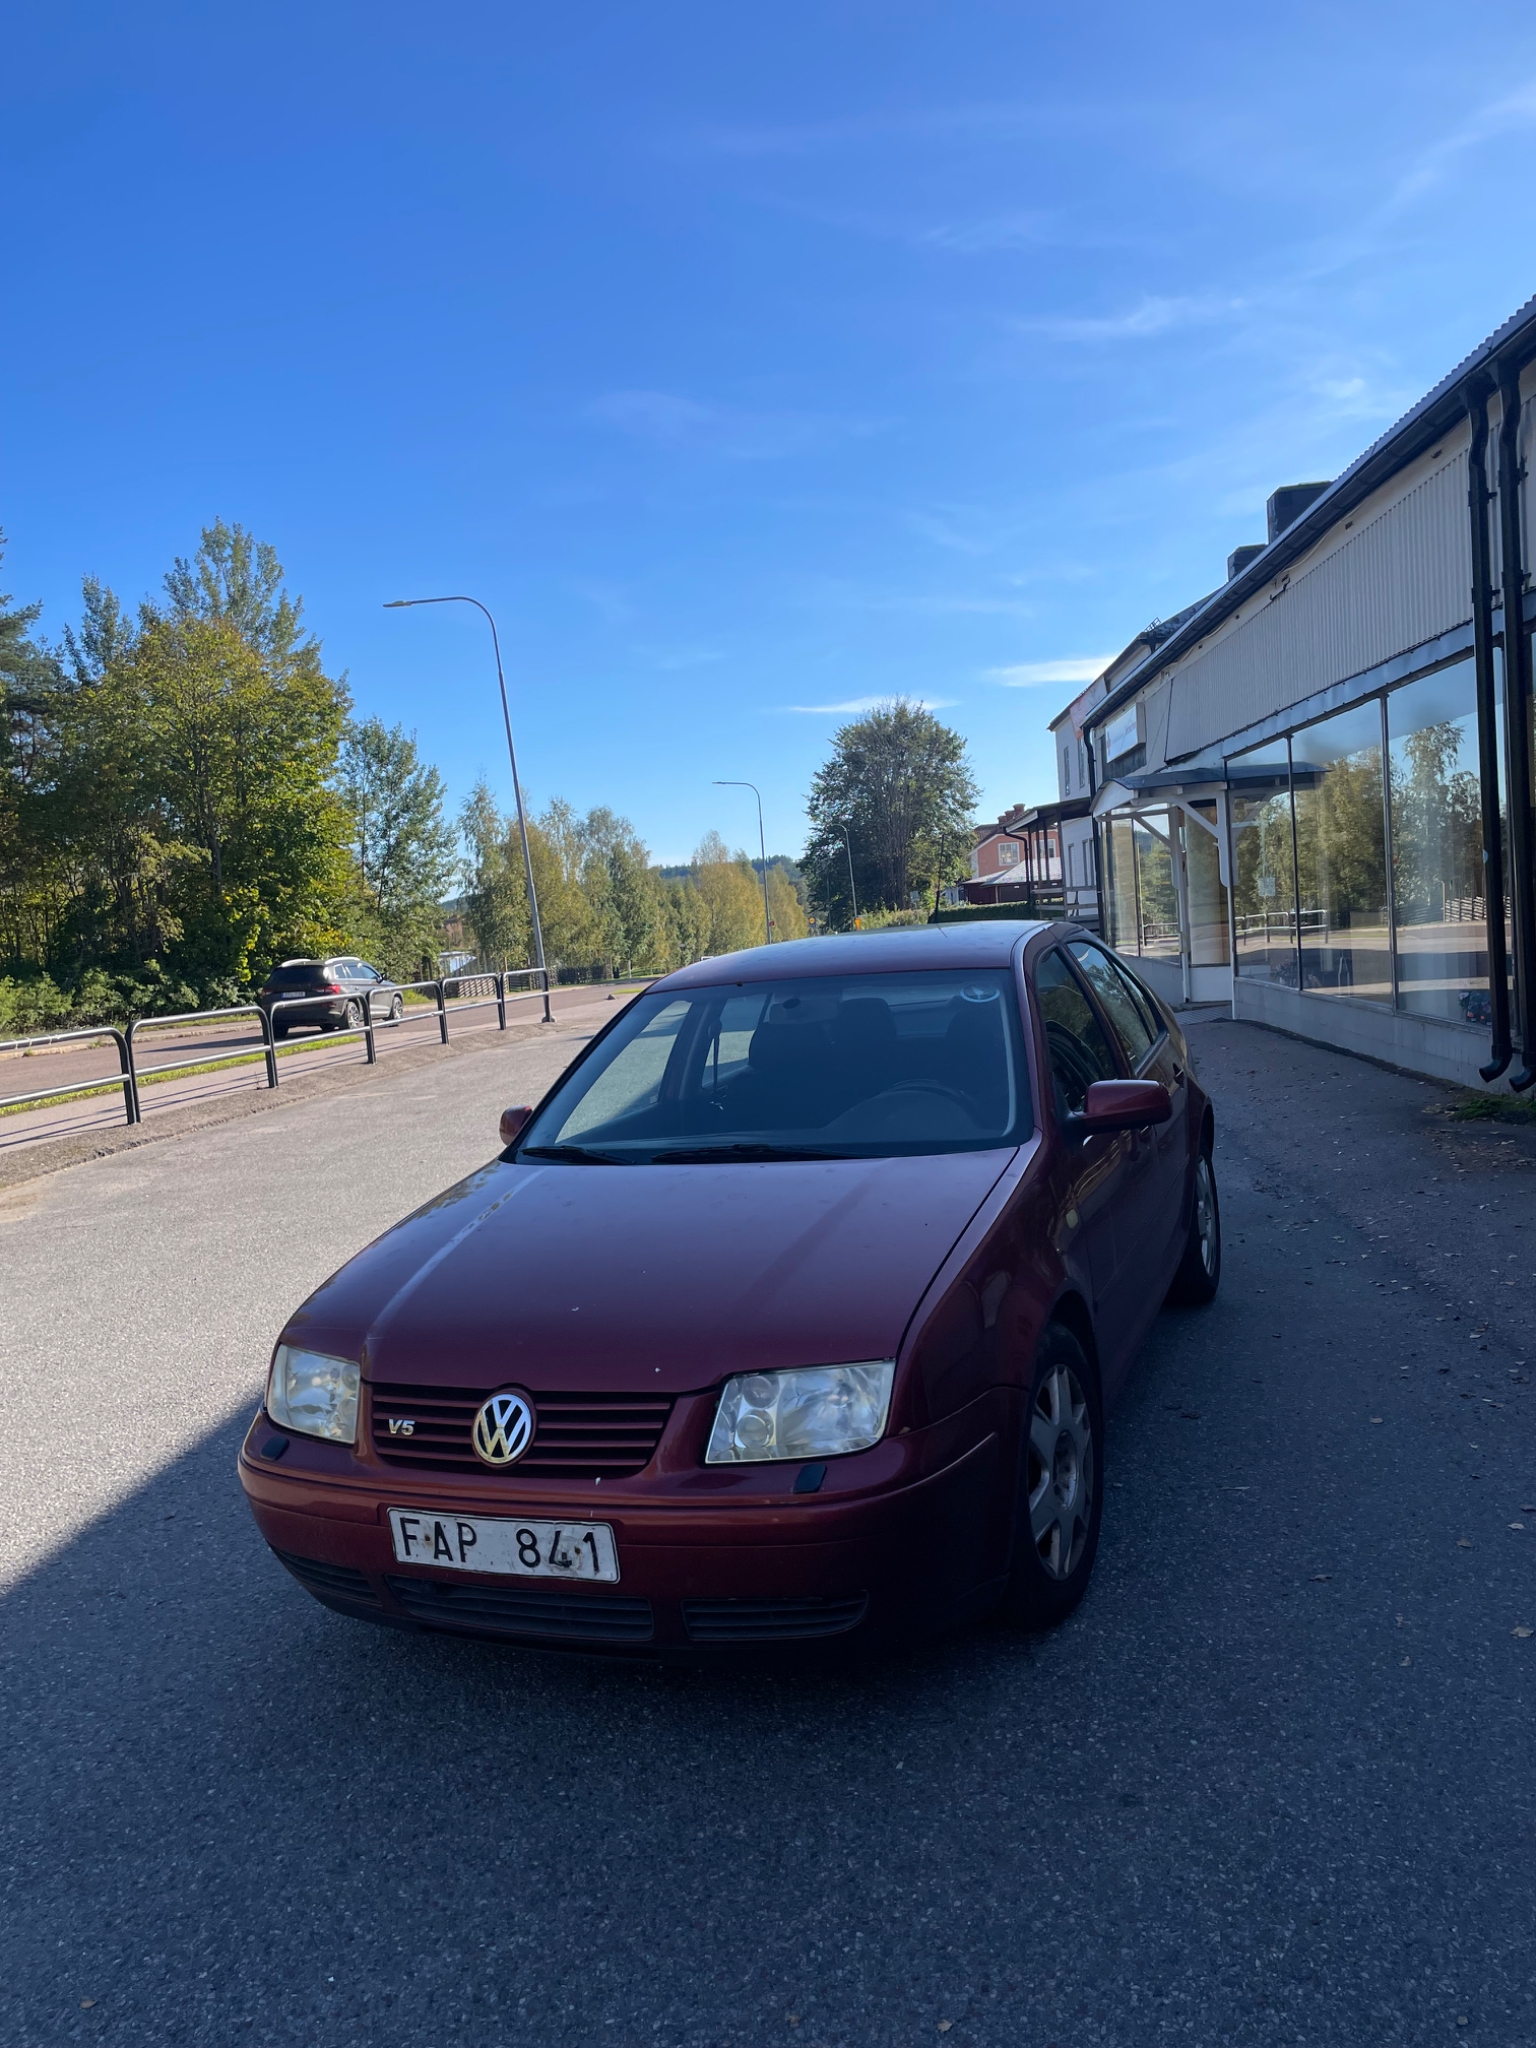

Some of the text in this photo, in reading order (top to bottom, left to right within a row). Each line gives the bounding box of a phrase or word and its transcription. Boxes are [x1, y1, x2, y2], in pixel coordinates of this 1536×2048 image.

[388, 1418, 416, 1436] V5
[473, 1393, 532, 1464] VW
[400, 1517, 600, 1576] FAP 841
